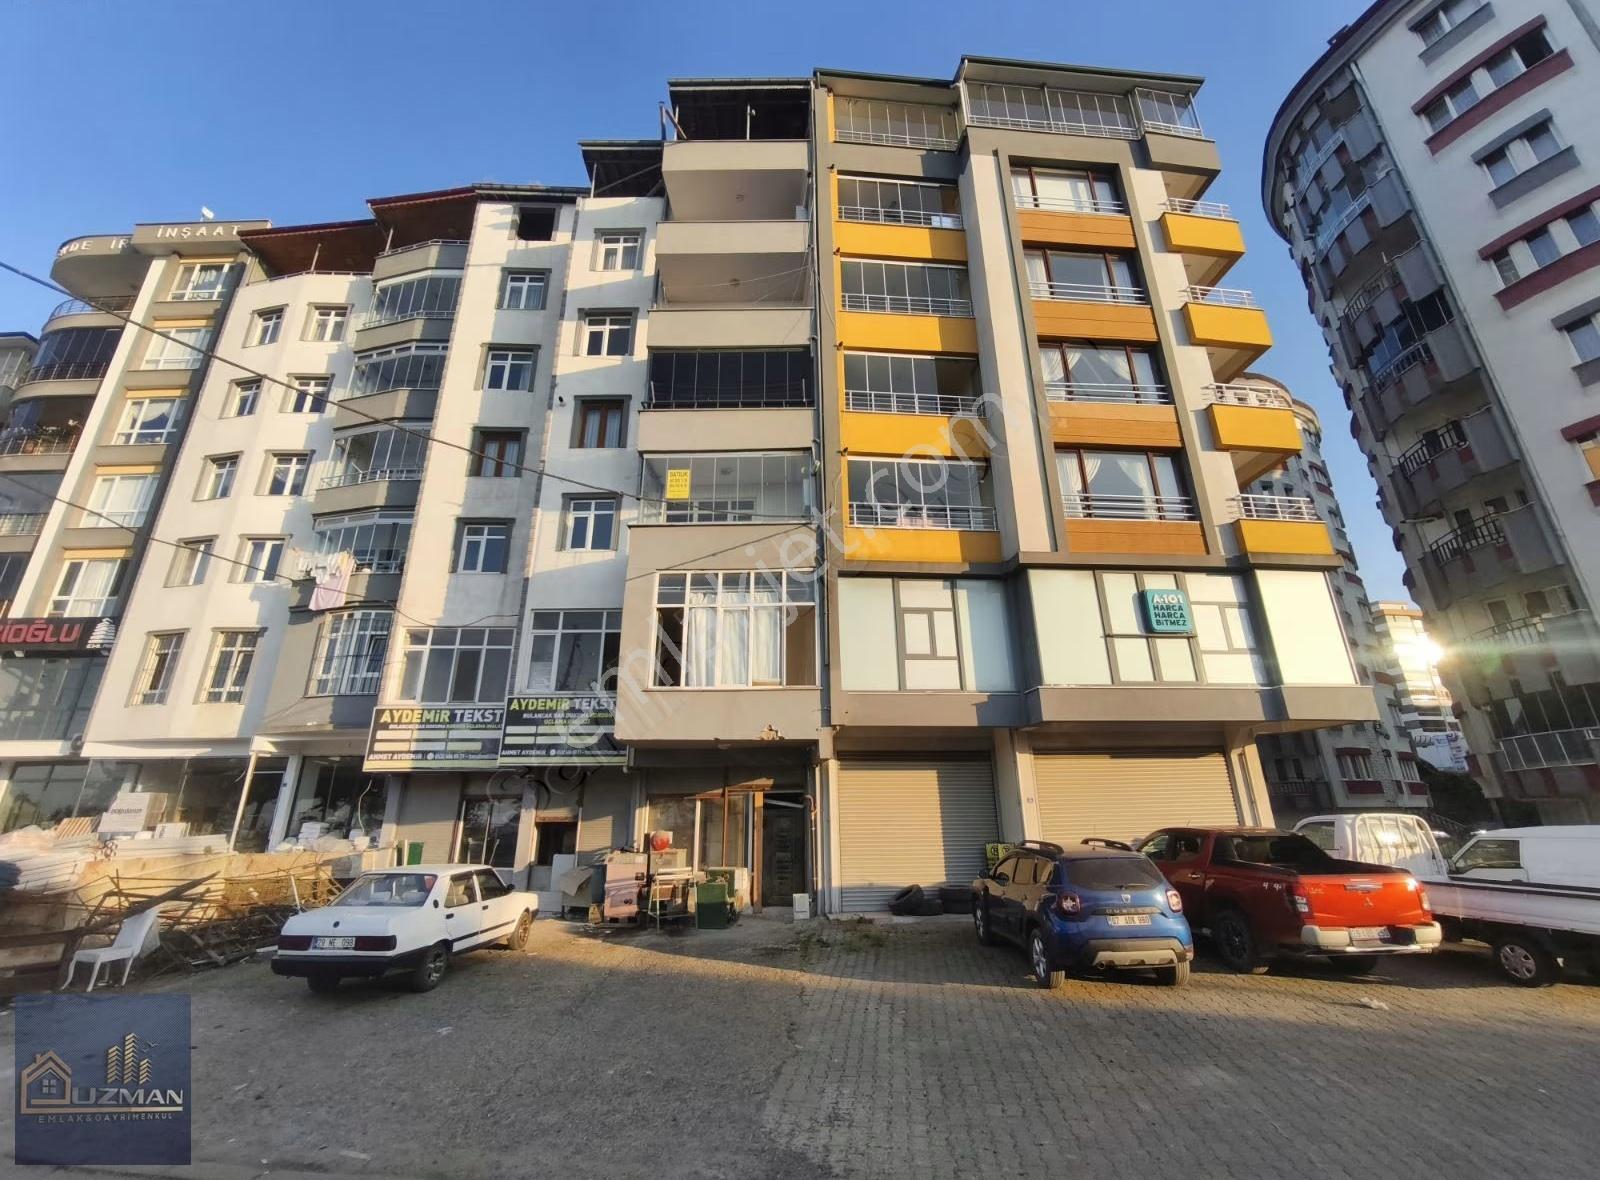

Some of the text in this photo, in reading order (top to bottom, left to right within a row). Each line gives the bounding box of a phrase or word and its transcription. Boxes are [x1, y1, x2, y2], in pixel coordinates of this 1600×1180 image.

[157, 225, 239, 239] İNŞAAT
[0, 618, 80, 643] İOĞLU
[453, 709, 504, 723] TEKST
